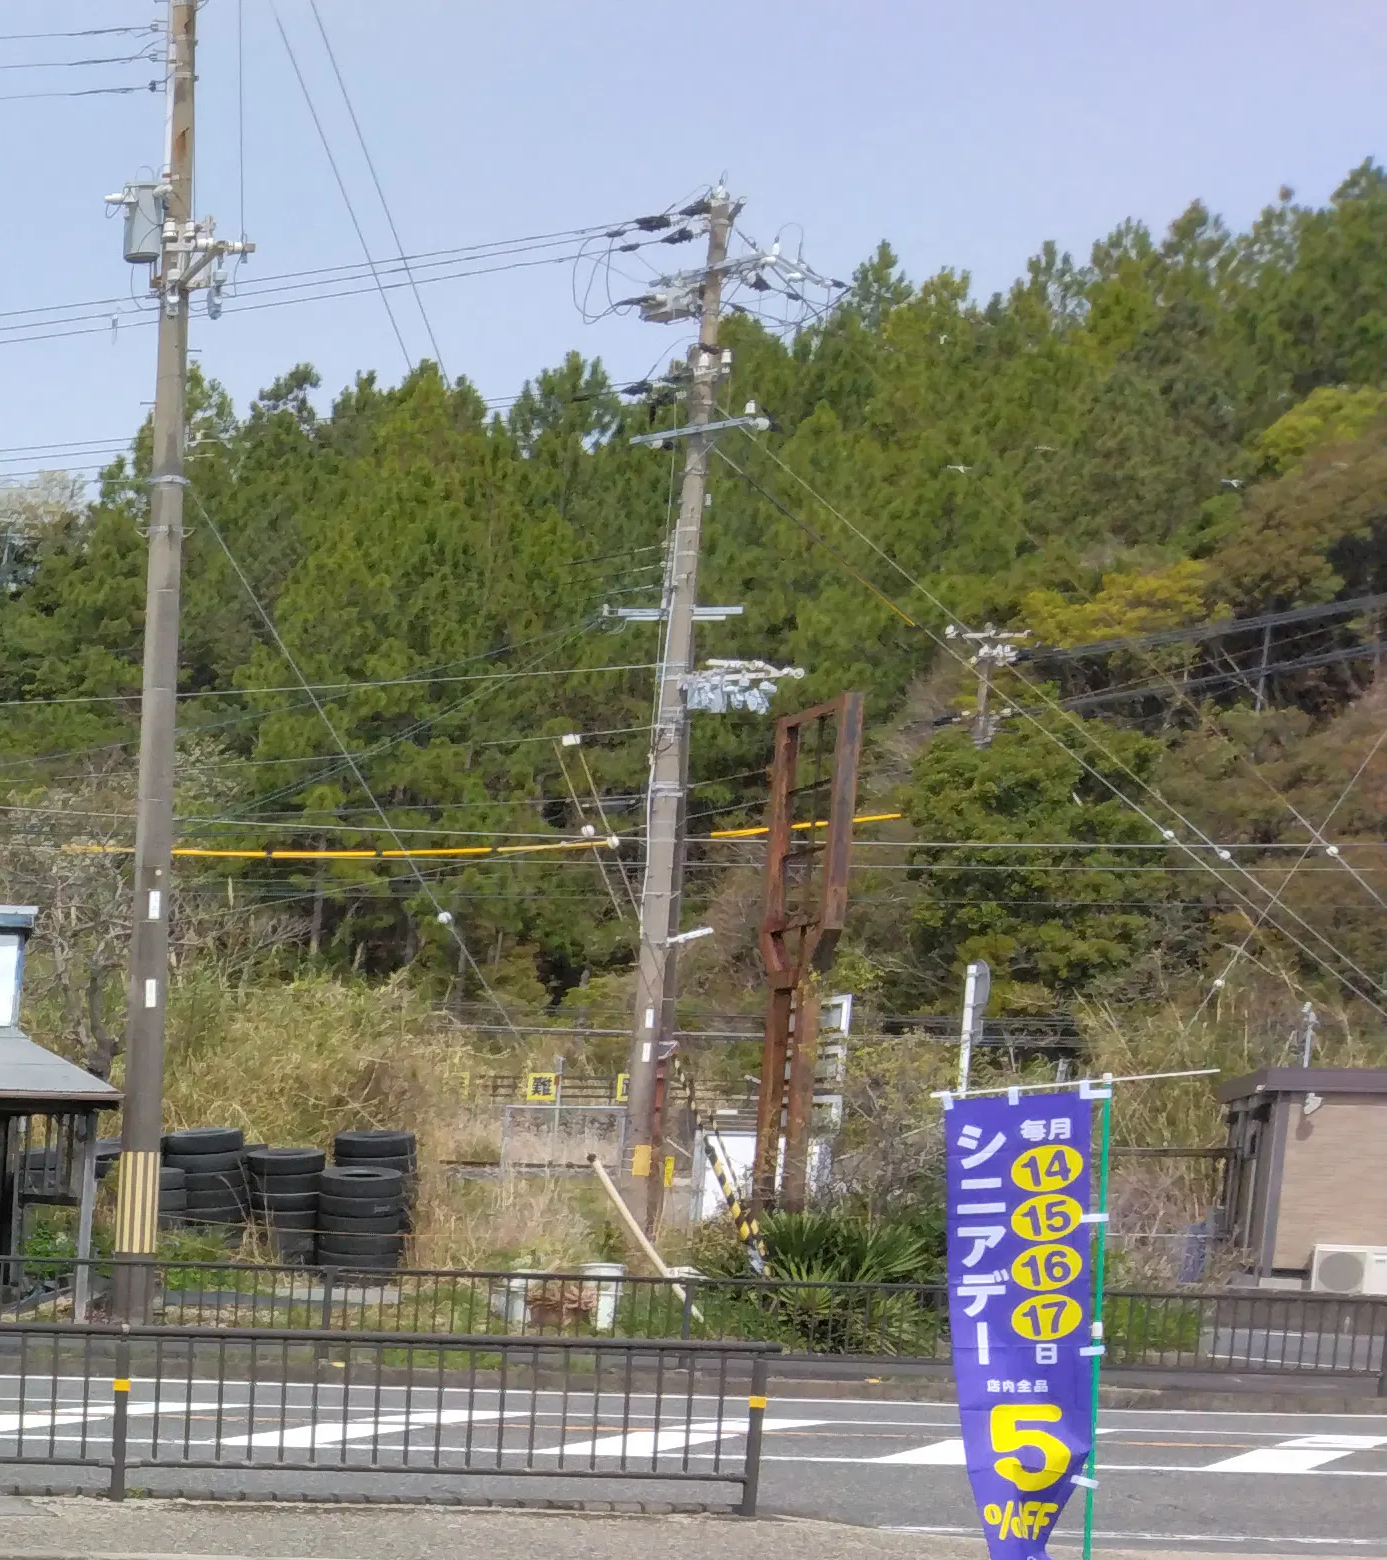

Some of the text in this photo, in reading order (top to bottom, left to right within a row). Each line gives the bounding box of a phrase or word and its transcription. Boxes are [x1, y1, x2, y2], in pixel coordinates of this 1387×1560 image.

[1020, 1118, 1071, 1141] 毎月
[1021, 1150, 1071, 1187] 14
[1021, 1200, 1071, 1236] 15
[957, 1124, 1009, 1365] シニアデー
[1021, 1250, 1071, 1286] 16
[1021, 1300, 1068, 1337] 17
[1036, 1343, 1057, 1364] 日
[987, 1379, 1048, 1393] 店内全品
[990, 1404, 1071, 1492] 5
